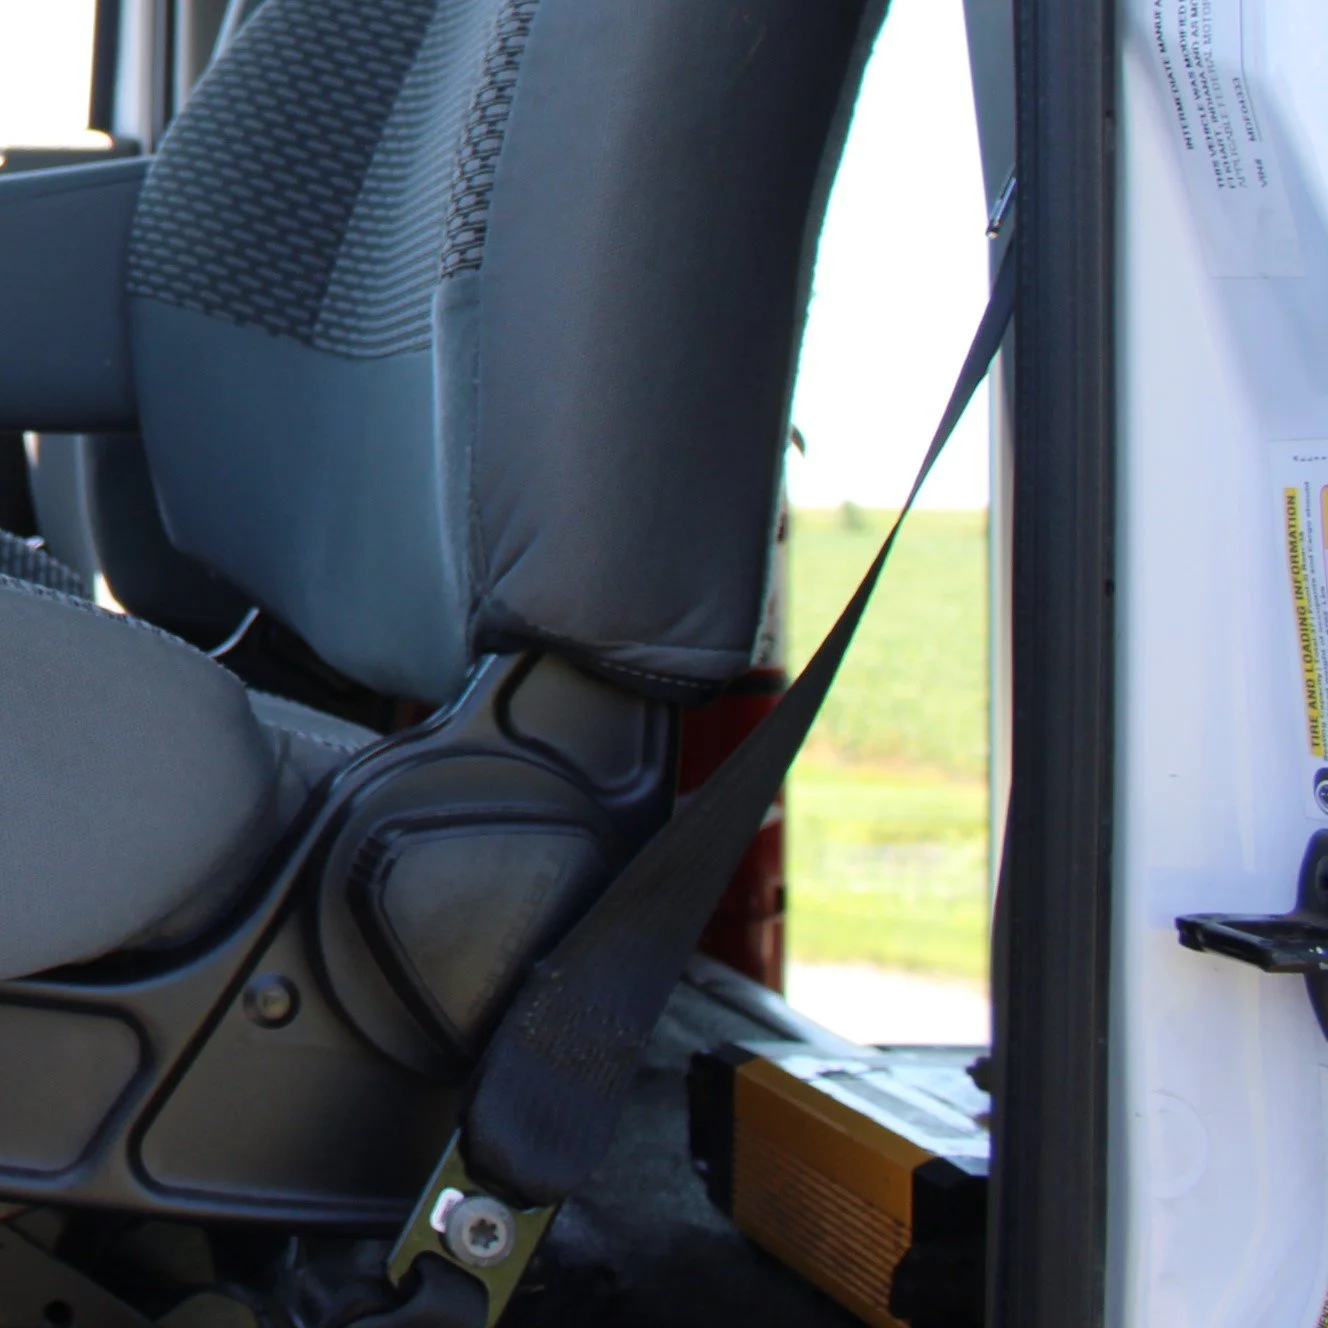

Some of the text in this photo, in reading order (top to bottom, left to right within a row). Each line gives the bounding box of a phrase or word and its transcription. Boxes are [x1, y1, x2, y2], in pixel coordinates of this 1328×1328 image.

[1178, 5, 1193, 68] MODIFIED
[1191, 41, 1204, 68] AND
[1163, 59, 1195, 150] INTERMEDIATE
[1188, 72, 1201, 100] WAS
[1199, 71, 1219, 123] INDIANA
[1203, 49, 1226, 107] FEDERAL
[1197, 104, 1217, 157] VEHICLE
[1220, 112, 1247, 188] APPLICABLE
[1213, 160, 1225, 189] THIS
[1286, 495, 1320, 747] TIRE AND LOADING INFORMATION
